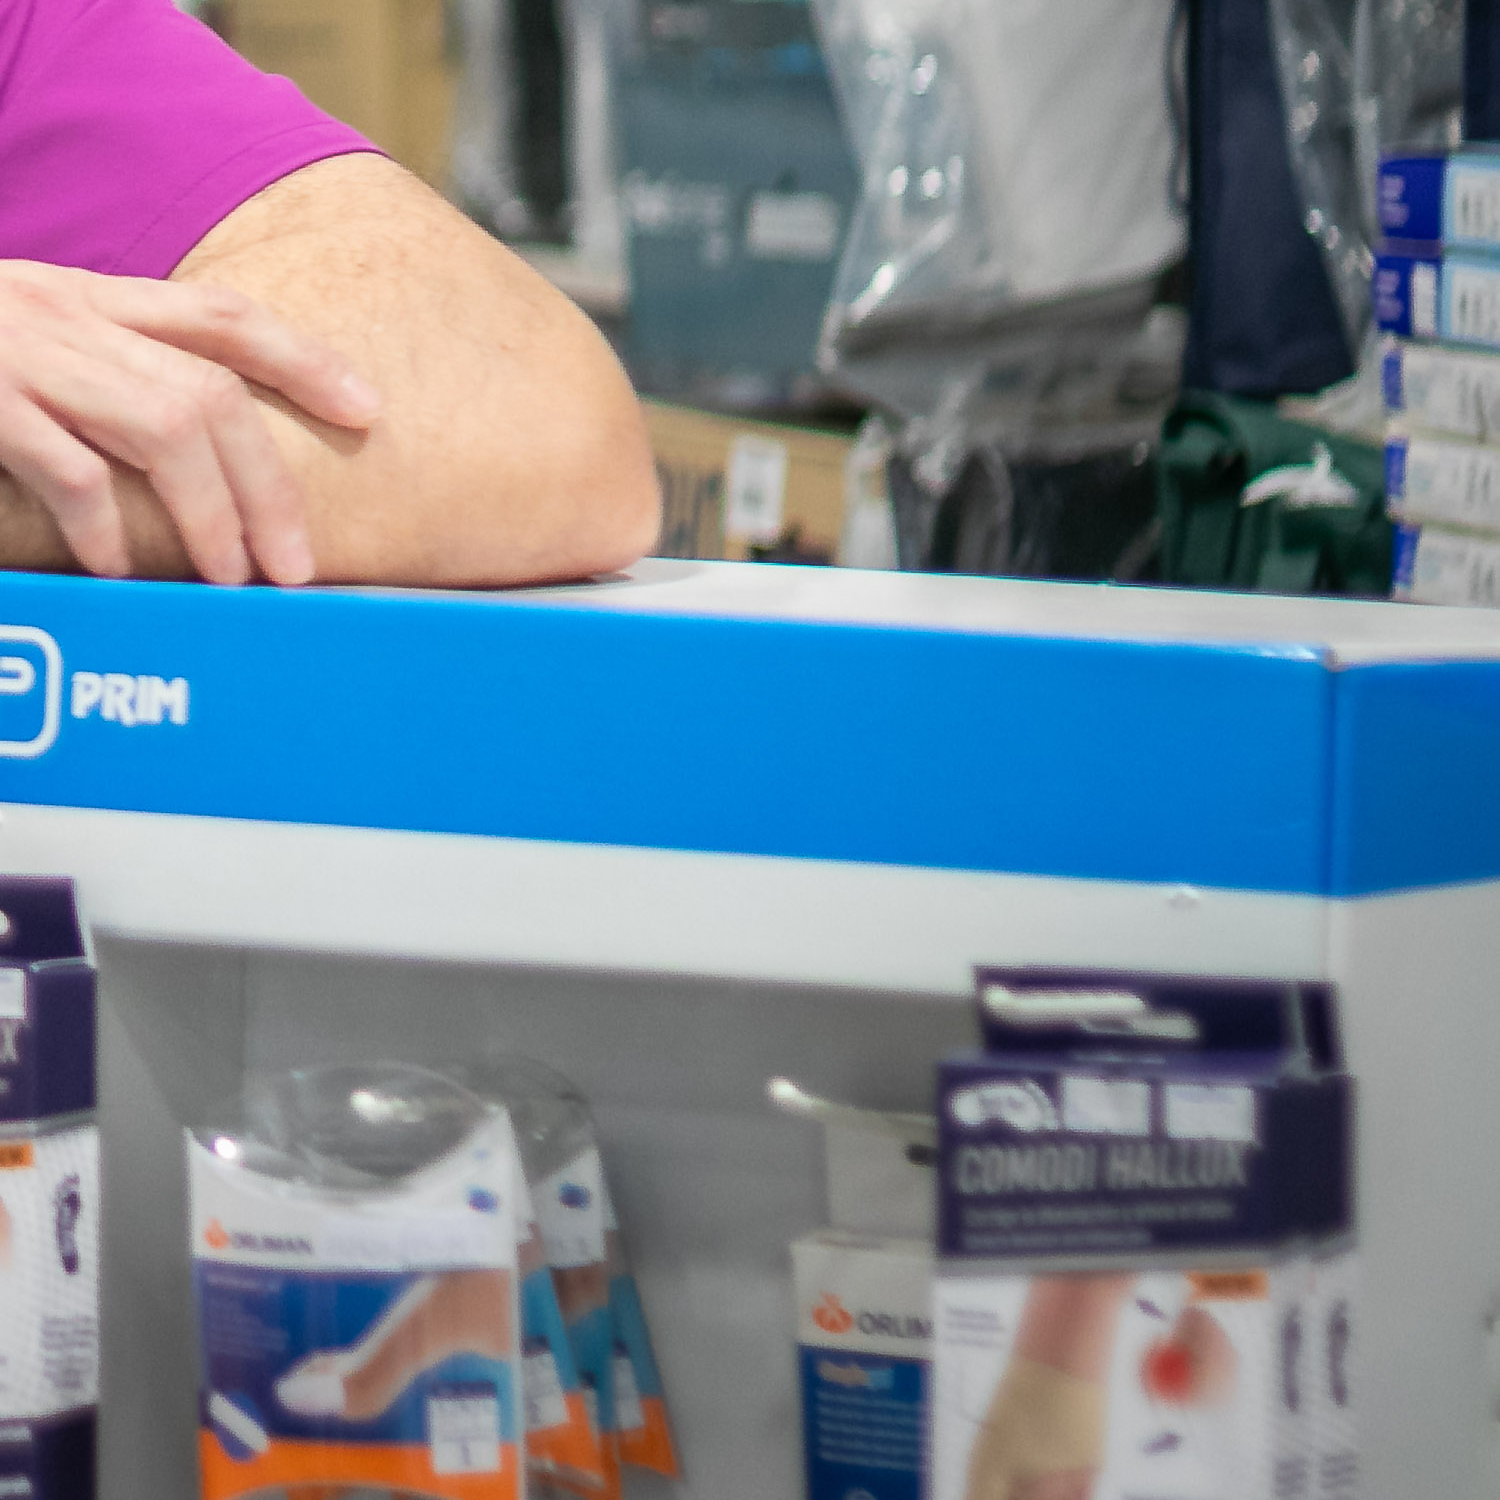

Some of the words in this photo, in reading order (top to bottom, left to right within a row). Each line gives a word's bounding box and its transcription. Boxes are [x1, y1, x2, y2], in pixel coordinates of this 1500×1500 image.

[70, 671, 190, 727] PRIM
[956, 1145, 1097, 1195] COMODI
[1105, 1140, 1247, 1190] HALLUX
